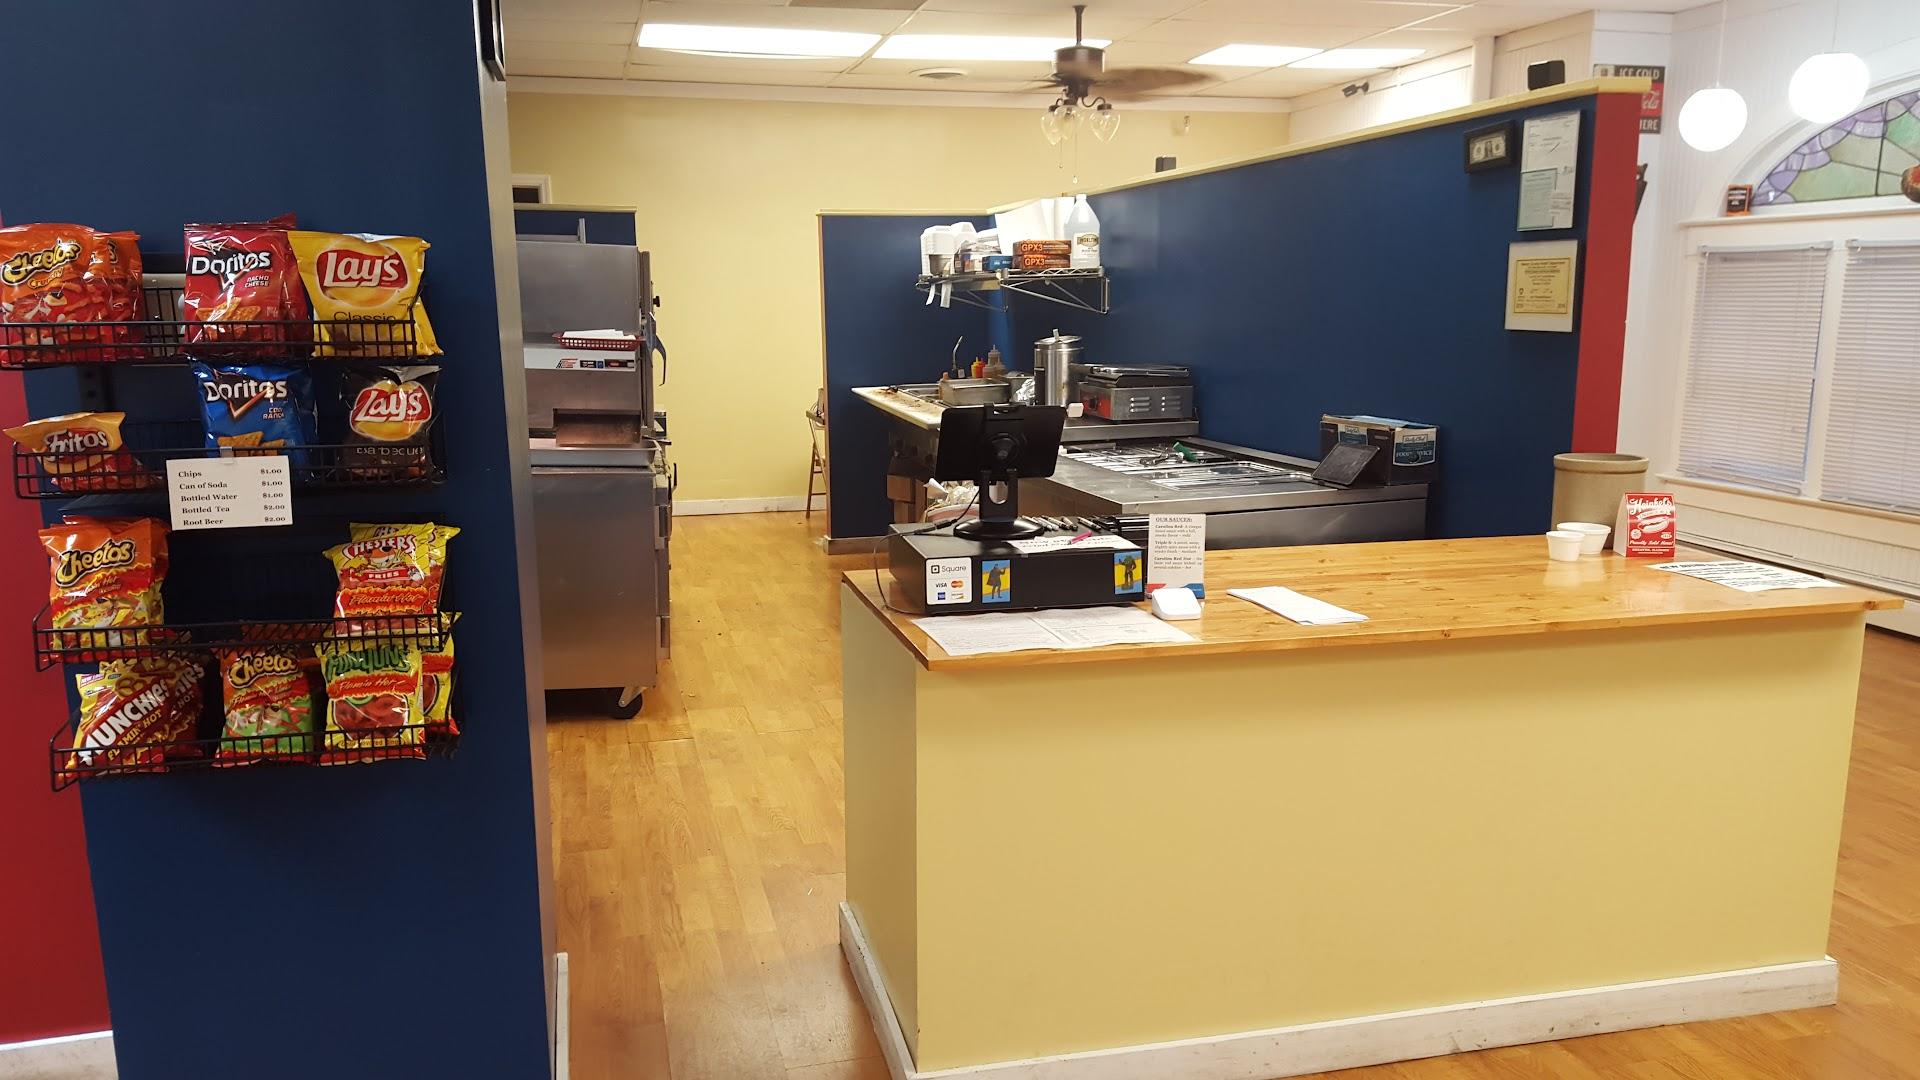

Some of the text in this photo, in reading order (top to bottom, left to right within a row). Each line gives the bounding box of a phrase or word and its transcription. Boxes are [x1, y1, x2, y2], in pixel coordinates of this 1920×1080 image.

[1636, 68, 1660, 80] COLD
[1021, 244, 1043, 252] GPX3
[191, 251, 272, 275] Doritos
[1024, 258, 1045, 266] GPX3
[323, 251, 401, 288] Lay's
[203, 380, 288, 402] Doritos
[354, 389, 423, 422] Lay's
[45, 428, 108, 453] Fritos
[207, 481, 228, 489] Soda
[181, 494, 211, 502] Bottled
[213, 493, 238, 501] Water
[182, 506, 212, 514] Bottled
[56, 540, 133, 584] Cheetos
[368, 570, 400, 579] FRIES
[941, 565, 967, 573] Square
[143, 709, 162, 729] HOT
